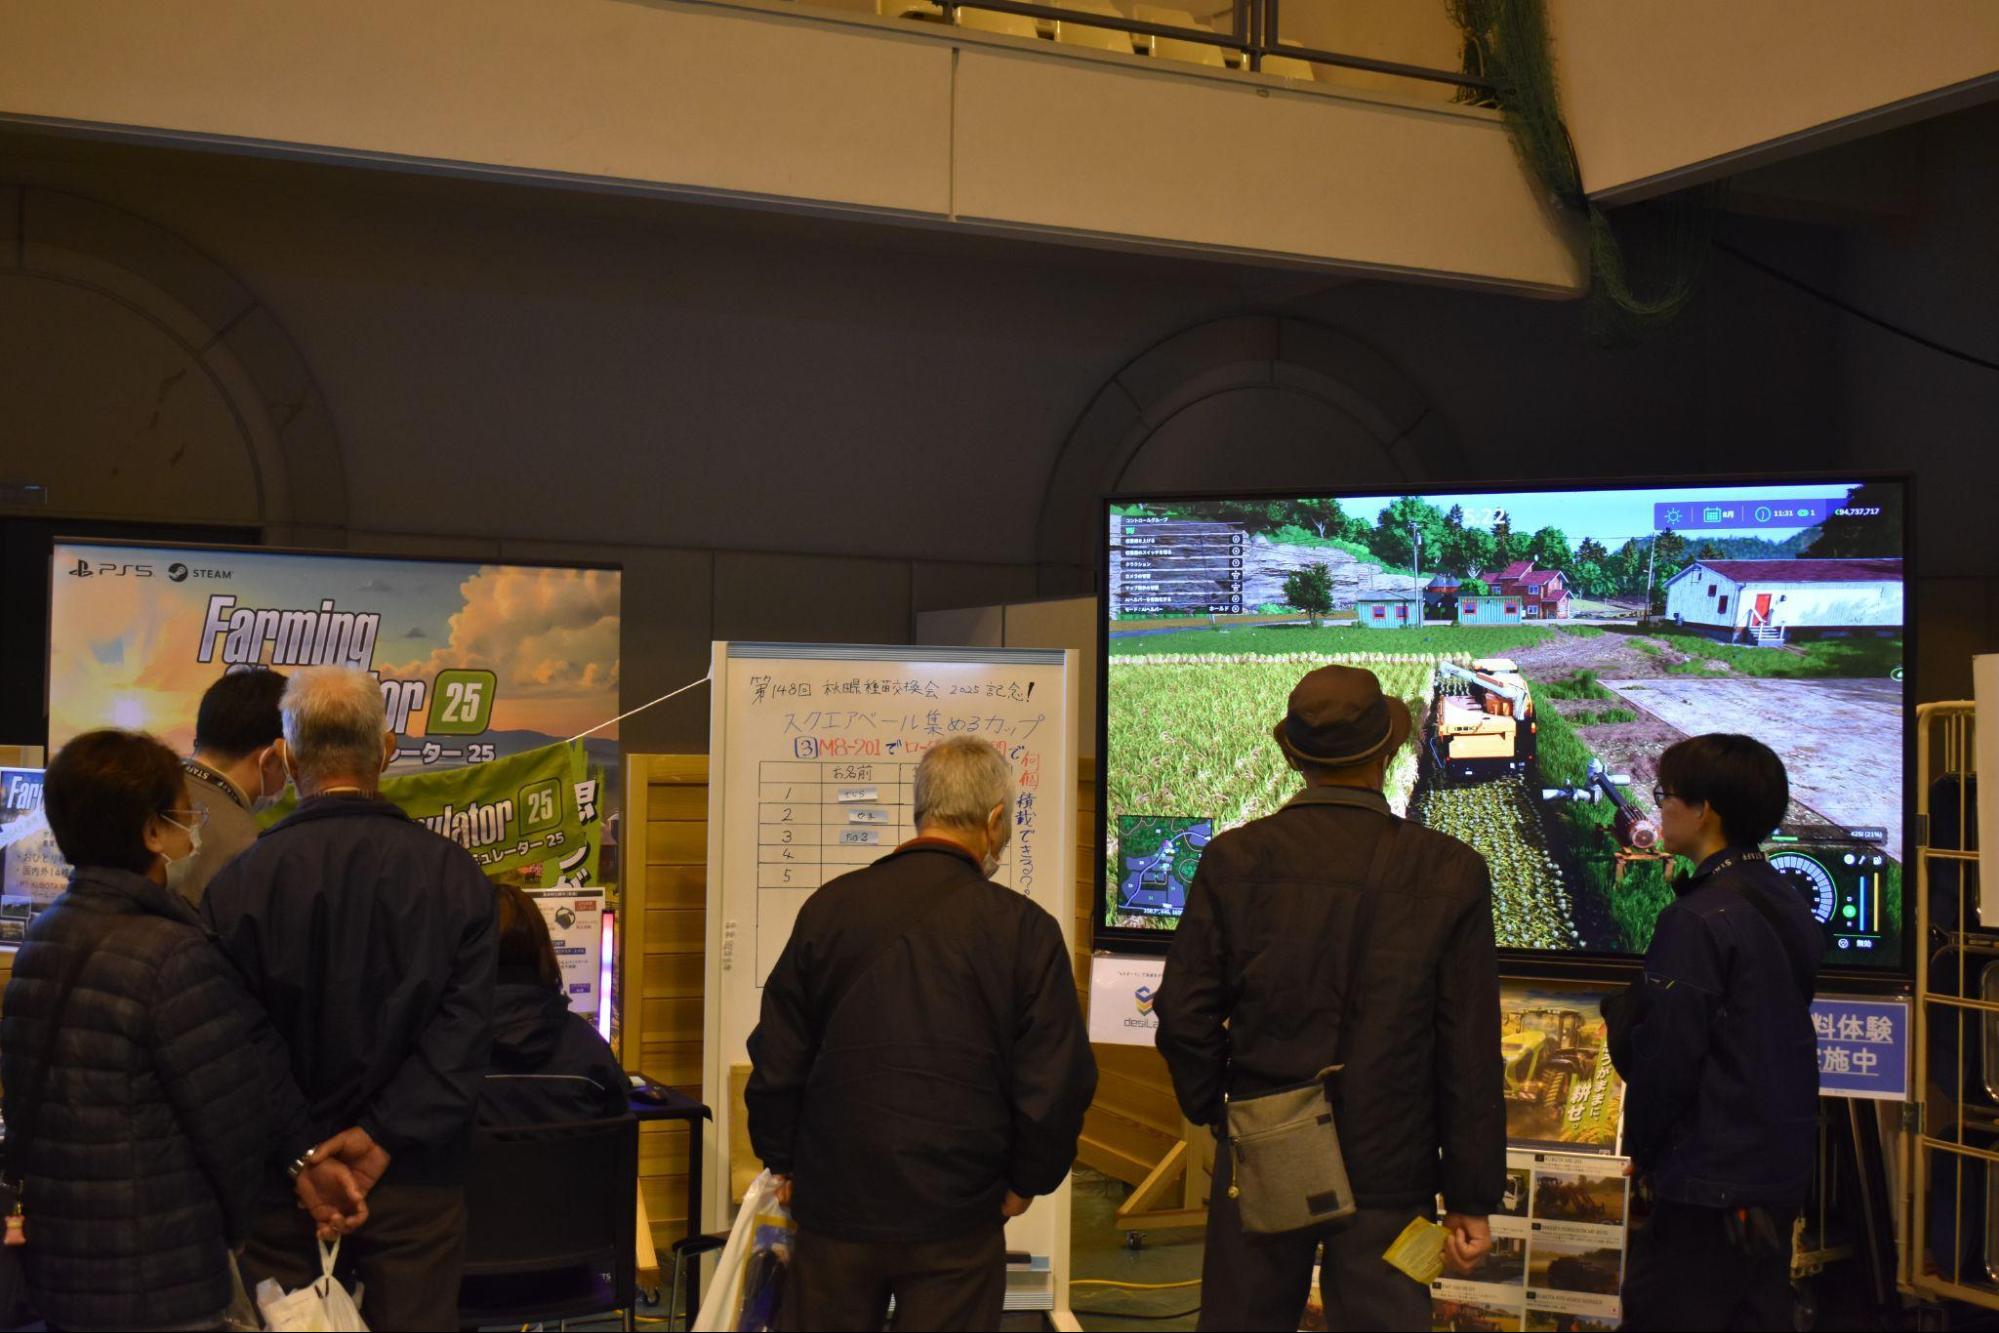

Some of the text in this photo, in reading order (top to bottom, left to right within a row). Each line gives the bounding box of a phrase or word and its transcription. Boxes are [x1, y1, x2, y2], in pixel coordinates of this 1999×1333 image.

[98, 563, 152, 577] PS5
[193, 569, 232, 579] STEAM
[197, 594, 381, 672] Farming
[441, 682, 483, 723] 25
[468, 745, 496, 763] 25
[528, 788, 553, 825] 25
[781, 808, 793, 822] 2
[547, 832, 565, 847] 25
[781, 830, 793, 844] 3
[782, 848, 795, 859] 4
[783, 869, 792, 883] 5
[1816, 1045, 1878, 1075] 施中
